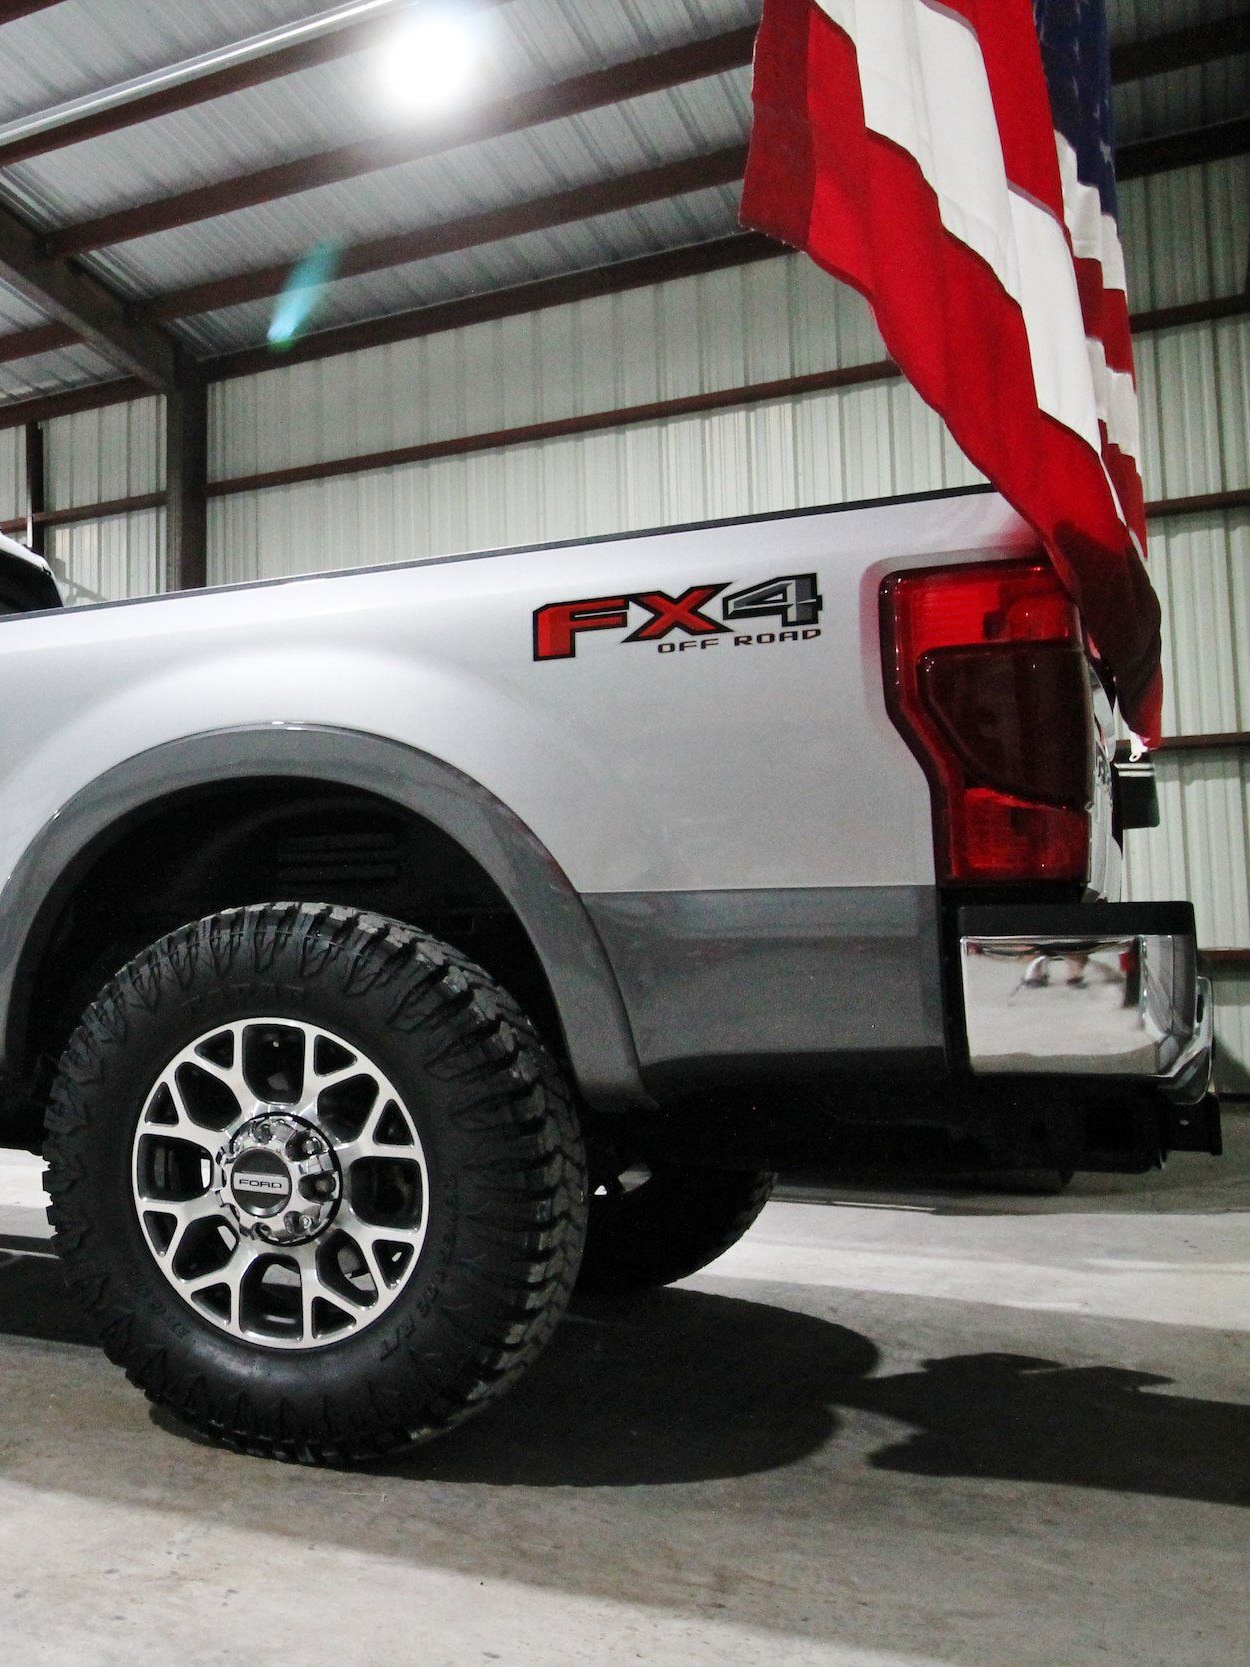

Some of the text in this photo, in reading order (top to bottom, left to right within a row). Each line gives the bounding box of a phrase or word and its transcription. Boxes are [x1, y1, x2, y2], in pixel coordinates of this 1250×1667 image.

[533, 573, 823, 661] FX4
[657, 628, 821, 654] OFF ROAD
[238, 1179, 283, 1189] FORD
